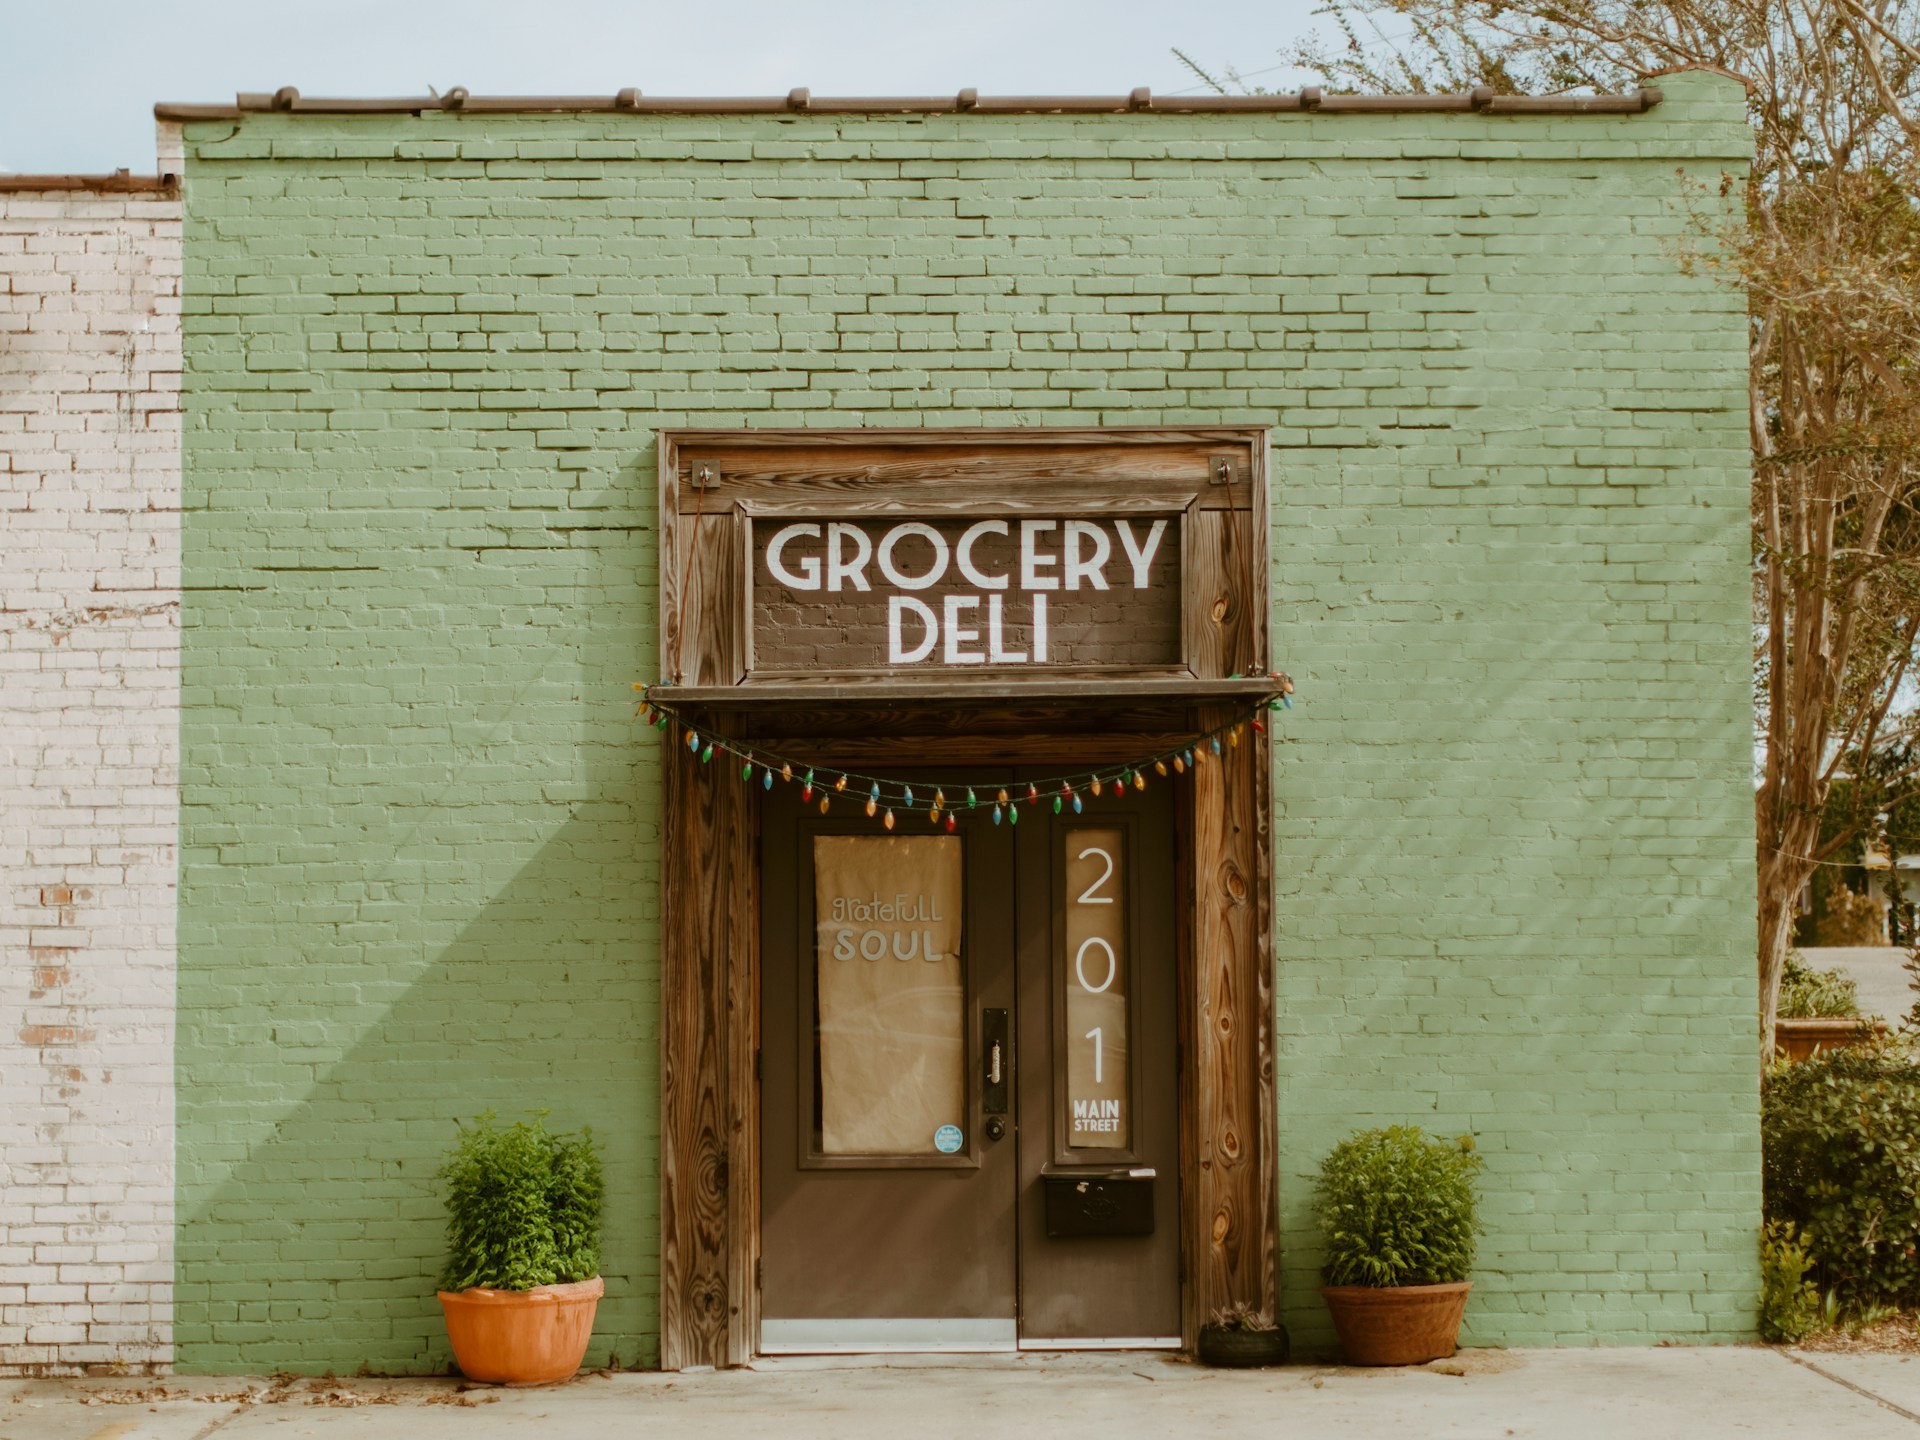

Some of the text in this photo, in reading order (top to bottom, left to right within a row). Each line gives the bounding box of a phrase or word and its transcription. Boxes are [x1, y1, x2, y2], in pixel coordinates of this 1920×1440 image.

[766, 519, 1168, 591] GROCERY
[888, 593, 1048, 664] DELI
[833, 929, 943, 962] SOUL
[1073, 1100, 1119, 1118] MAIN
[1074, 1119, 1119, 1132] STREET
